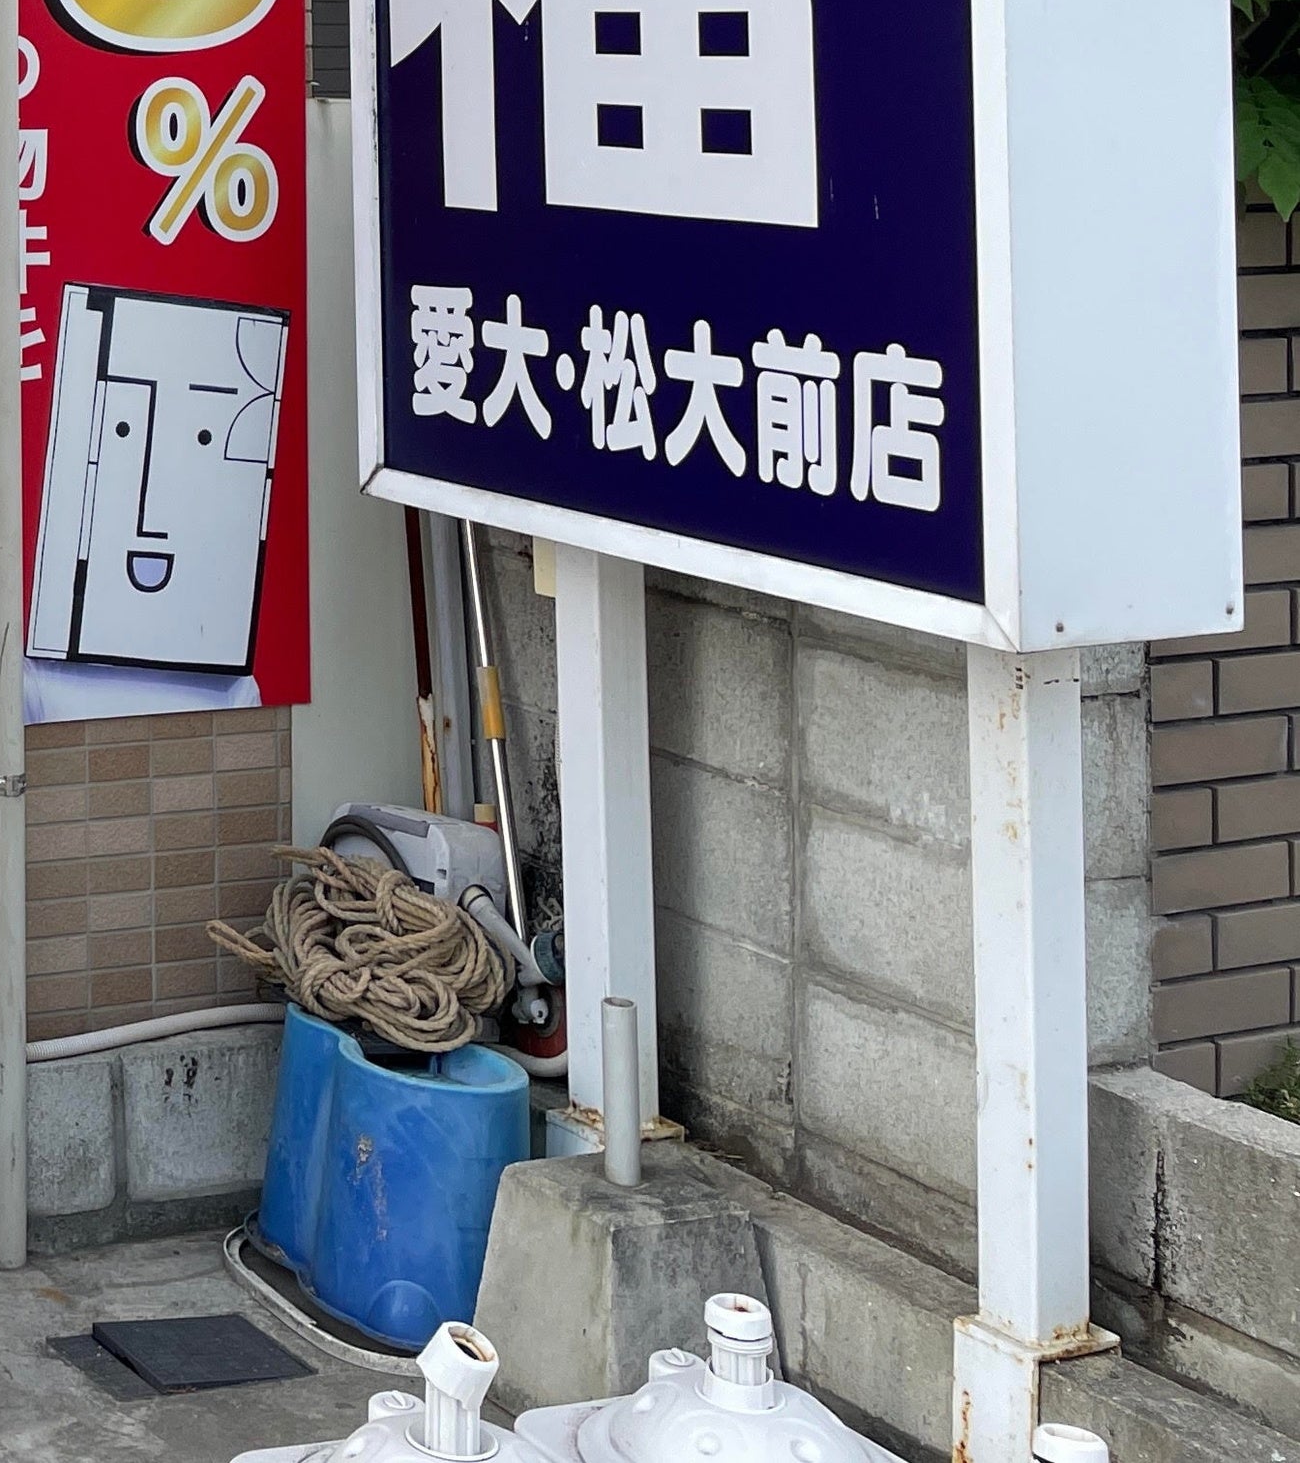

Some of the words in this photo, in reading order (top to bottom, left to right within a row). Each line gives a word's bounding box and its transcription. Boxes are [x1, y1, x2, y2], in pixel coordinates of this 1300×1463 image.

[410, 284, 945, 514] 愛大・松大前店
